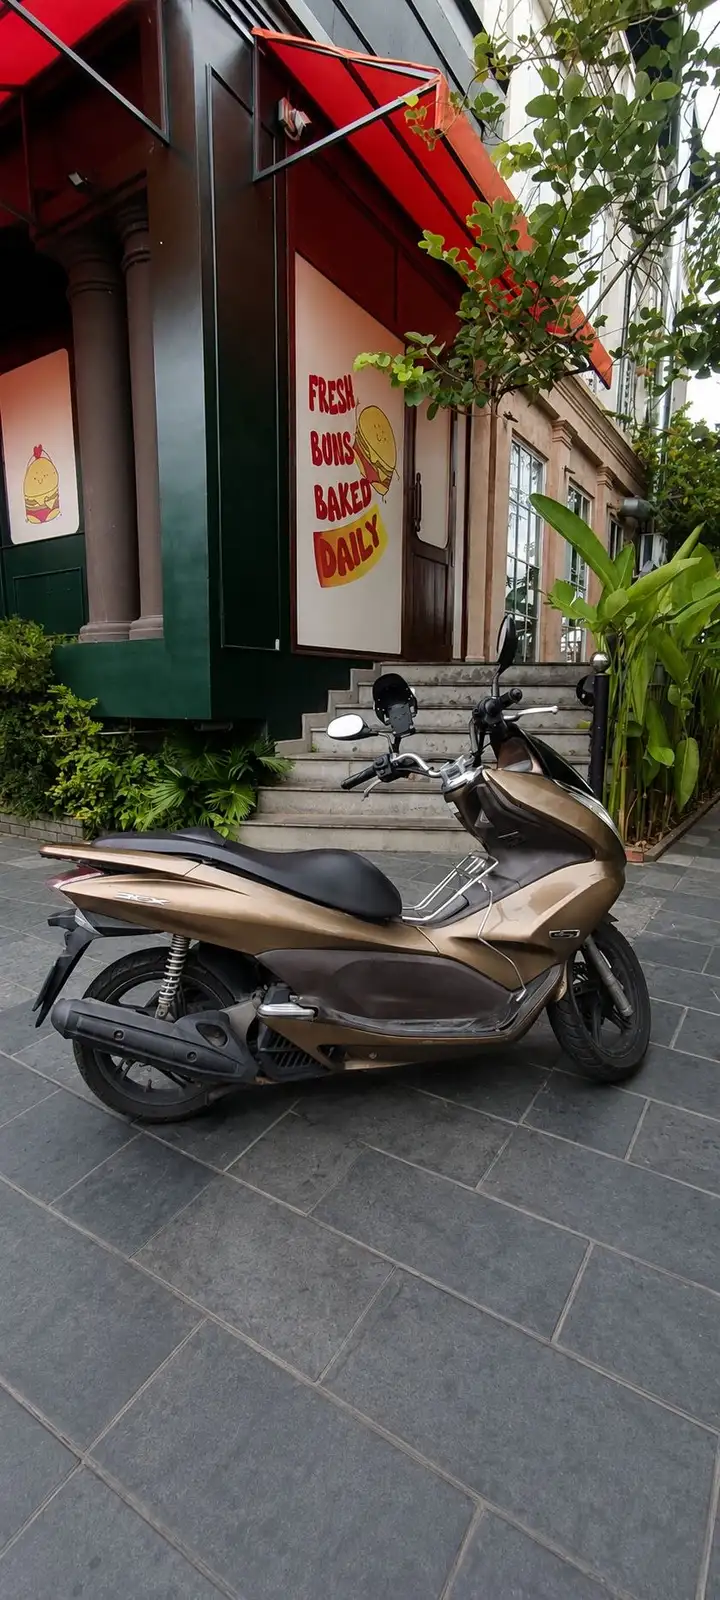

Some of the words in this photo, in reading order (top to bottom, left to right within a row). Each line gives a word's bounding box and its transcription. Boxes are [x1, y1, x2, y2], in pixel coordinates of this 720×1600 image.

[308, 374, 355, 415] FRESH
[310, 430, 355, 467] BUNS
[314, 477, 373, 522] BAKED
[319, 513, 380, 579] DAILY
